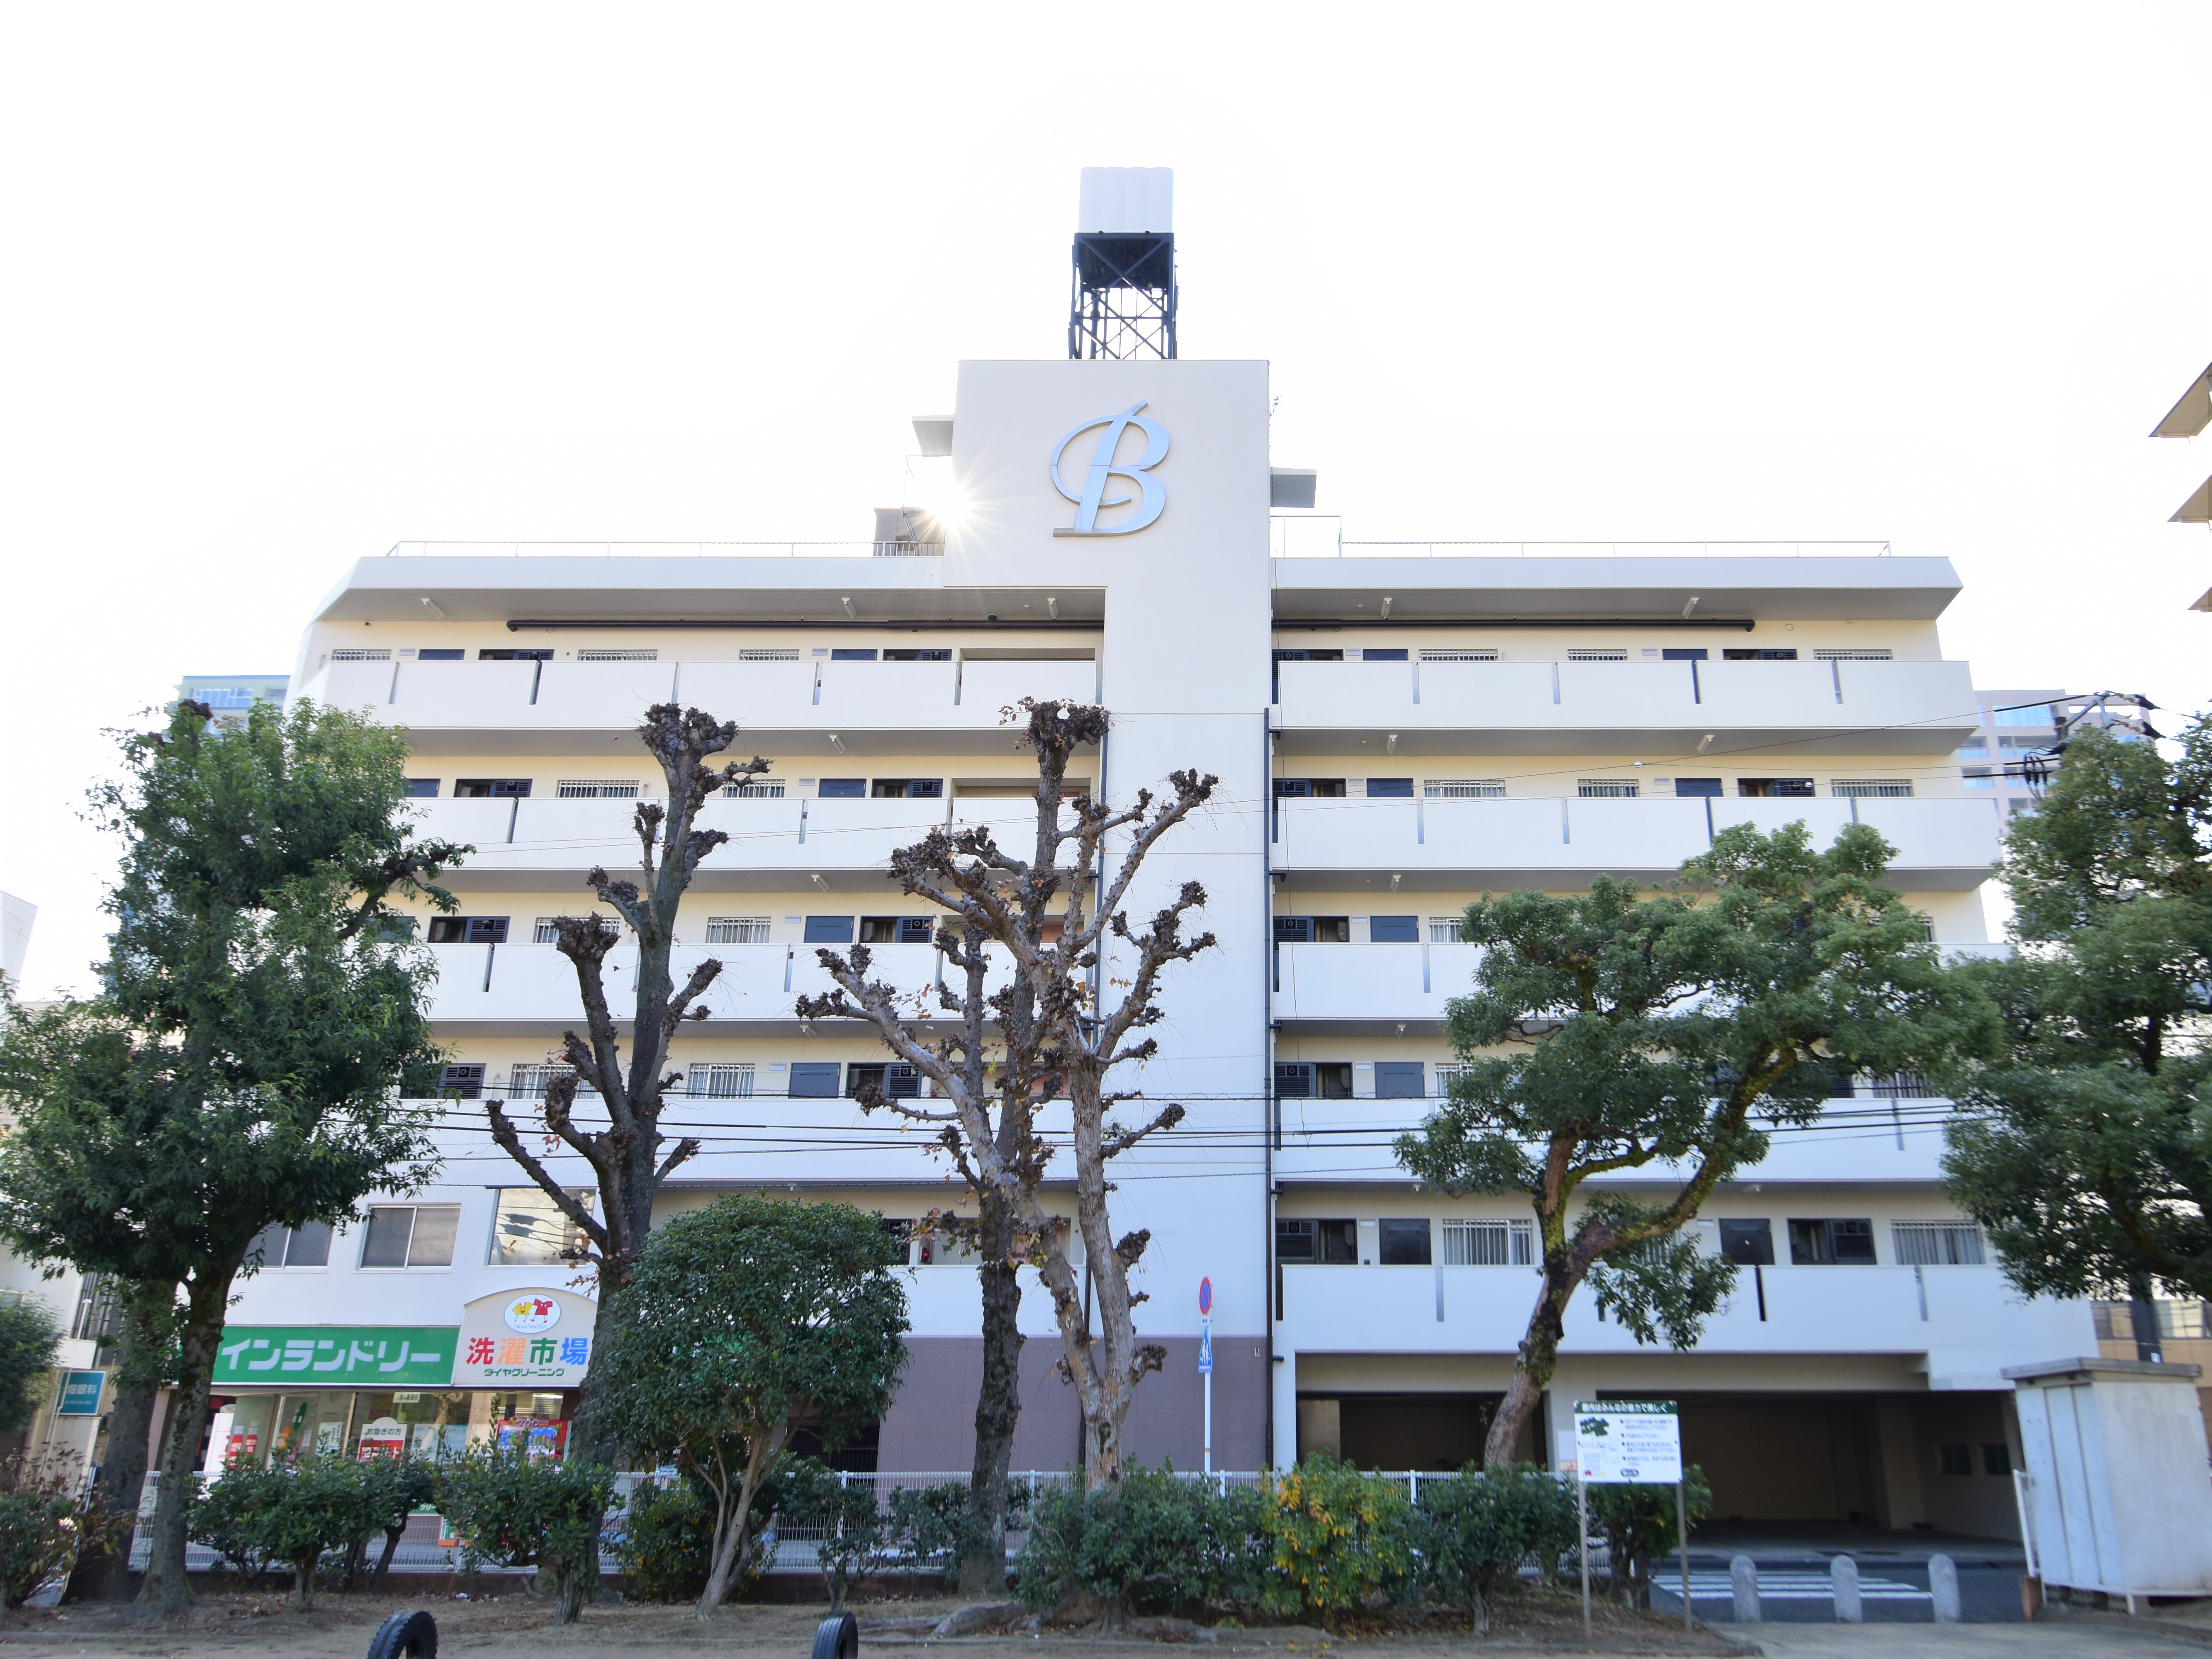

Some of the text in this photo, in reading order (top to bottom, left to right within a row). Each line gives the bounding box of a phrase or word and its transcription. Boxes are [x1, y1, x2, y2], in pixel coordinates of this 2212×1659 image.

[1050, 399, 1170, 537] B
[466, 1337, 588, 1365] 洗濯市場
[484, 1368, 565, 1377] ダイヤクリーニング
